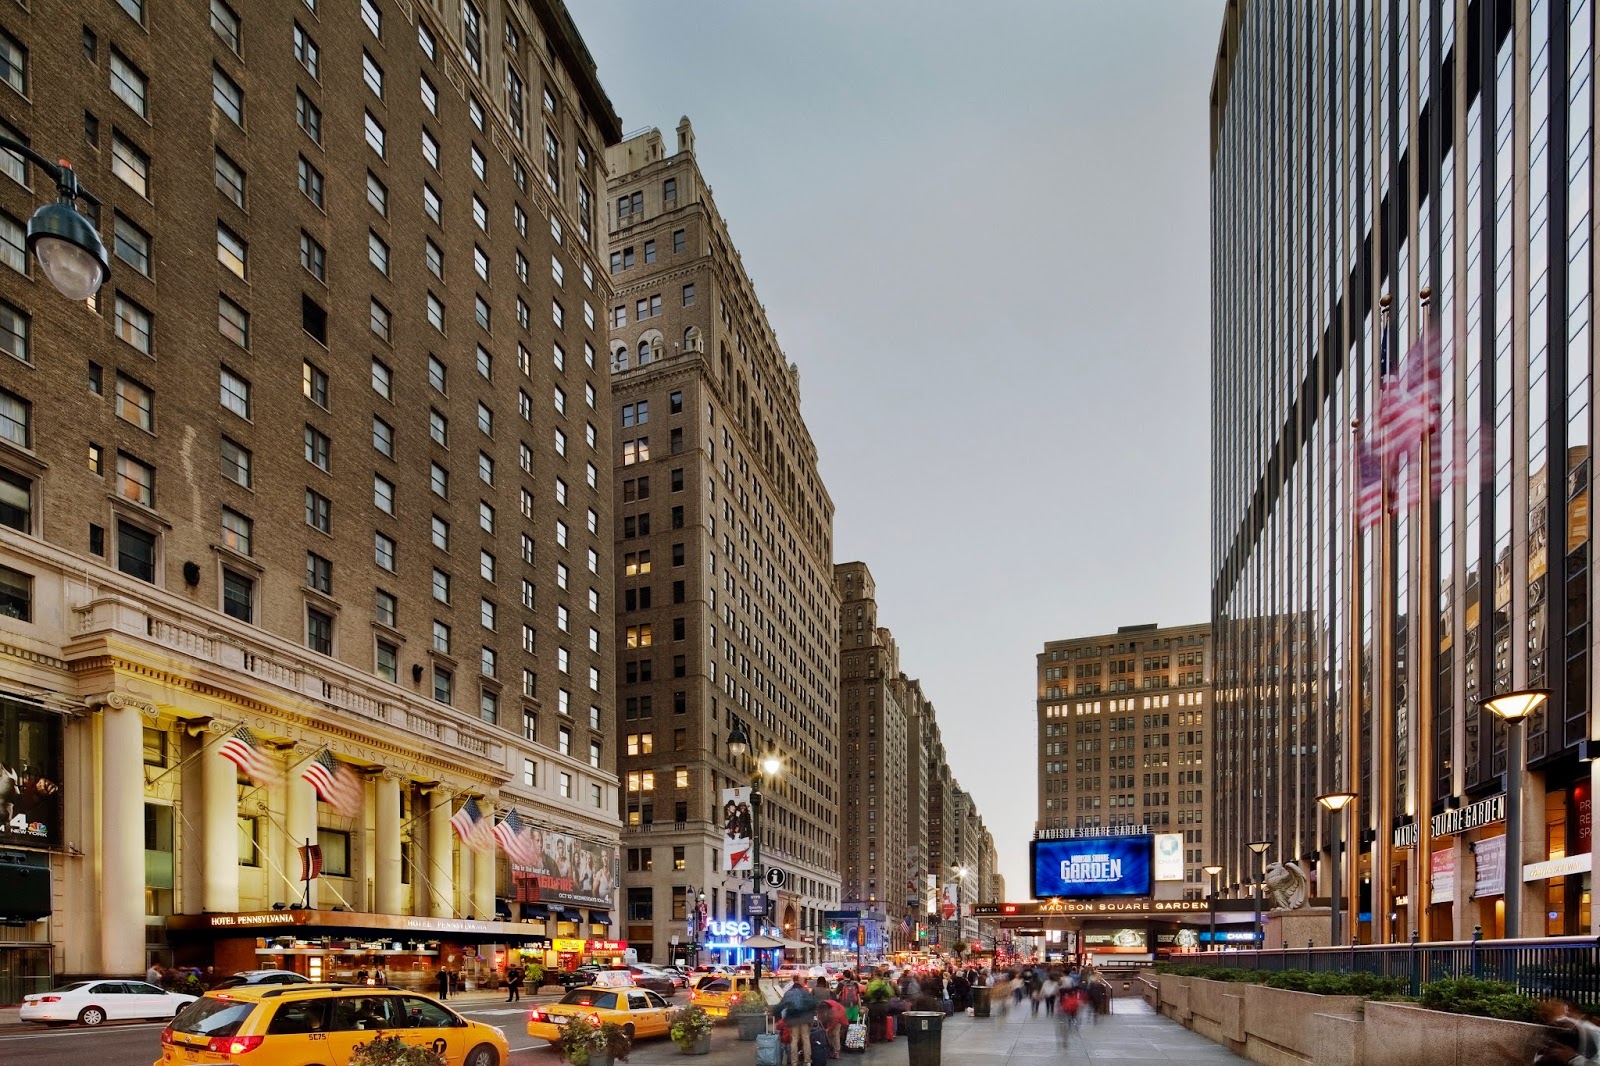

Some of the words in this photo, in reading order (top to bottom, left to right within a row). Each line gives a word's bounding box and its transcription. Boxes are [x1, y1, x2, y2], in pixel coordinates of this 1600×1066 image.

[10, 813, 28, 830] 4
[1394, 823, 1418, 848] MADIS
[1431, 809, 1464, 838] SQUARE
[1465, 796, 1505, 828] GARDEN
[28, 830, 48, 838] YORK
[1039, 828, 1075, 840] MADISON
[1080, 826, 1110, 838] SQUARE
[1115, 824, 1148, 836] GARDEN
[1060, 858, 1122, 880] GARDEN
[1099, 903, 1150, 911] SQUARE
[1155, 901, 1209, 910] GARDEN
[211, 916, 236, 926] HOTEL
[237, 913, 295, 925] PENNSYLVANIA
[407, 919, 432, 928] HOTEL
[437, 921, 487, 930] PENNSYLVANIA
[706, 917, 751, 936] fuse
